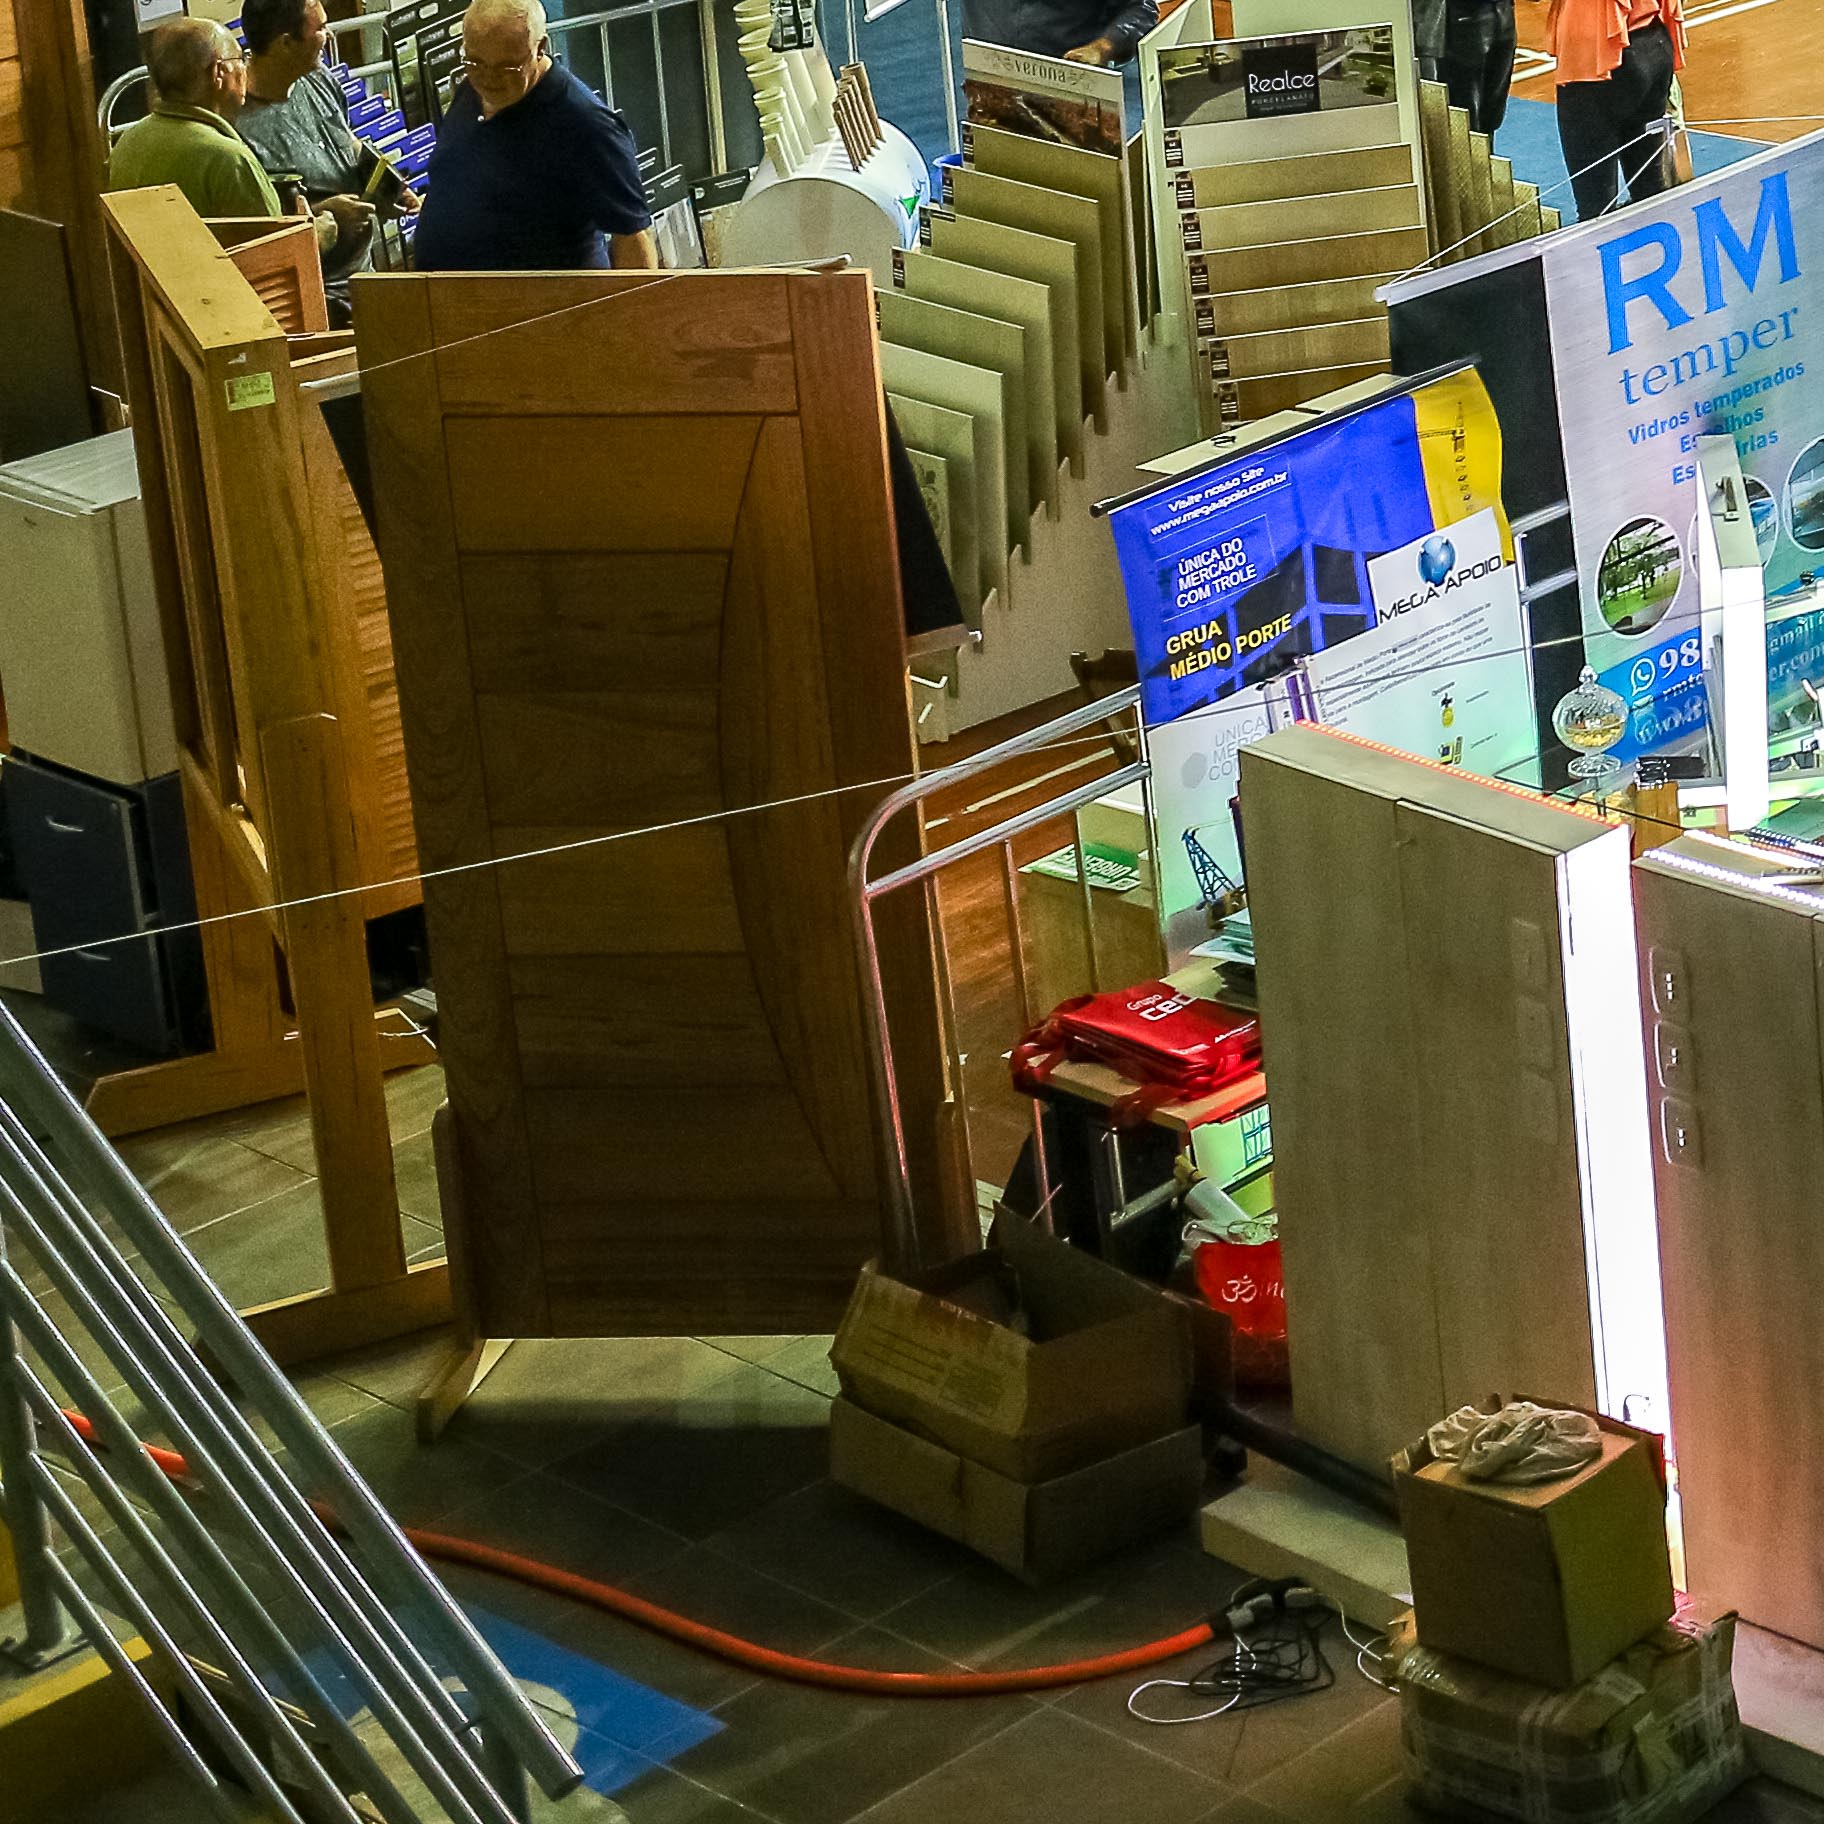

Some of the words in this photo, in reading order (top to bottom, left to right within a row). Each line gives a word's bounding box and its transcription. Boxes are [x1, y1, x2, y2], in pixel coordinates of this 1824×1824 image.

[1013, 59, 1067, 83] verona
[1248, 71, 1315, 94] Realce
[1596, 170, 1803, 356] RM
[1619, 301, 1800, 408] temper
[1628, 410, 1690, 445] Vidros
[1694, 361, 1804, 417] temperados
[1168, 491, 1203, 514] Visite
[1204, 477, 1240, 499] nosso
[1241, 466, 1265, 481] Site
[1178, 546, 1220, 576] ÚNICA
[1222, 537, 1242, 558] DO
[1178, 552, 1246, 592] MERCADO
[1176, 586, 1210, 608] COM
[1212, 564, 1257, 596] TROLE
[1379, 588, 1441, 625] MEGA
[1444, 555, 1502, 595] APOIO
[1166, 621, 1223, 655] GRUA
[1170, 642, 1232, 680] MÉDIO
[1237, 613, 1293, 654] PORTE
[1127, 994, 1162, 1011] Grupo
